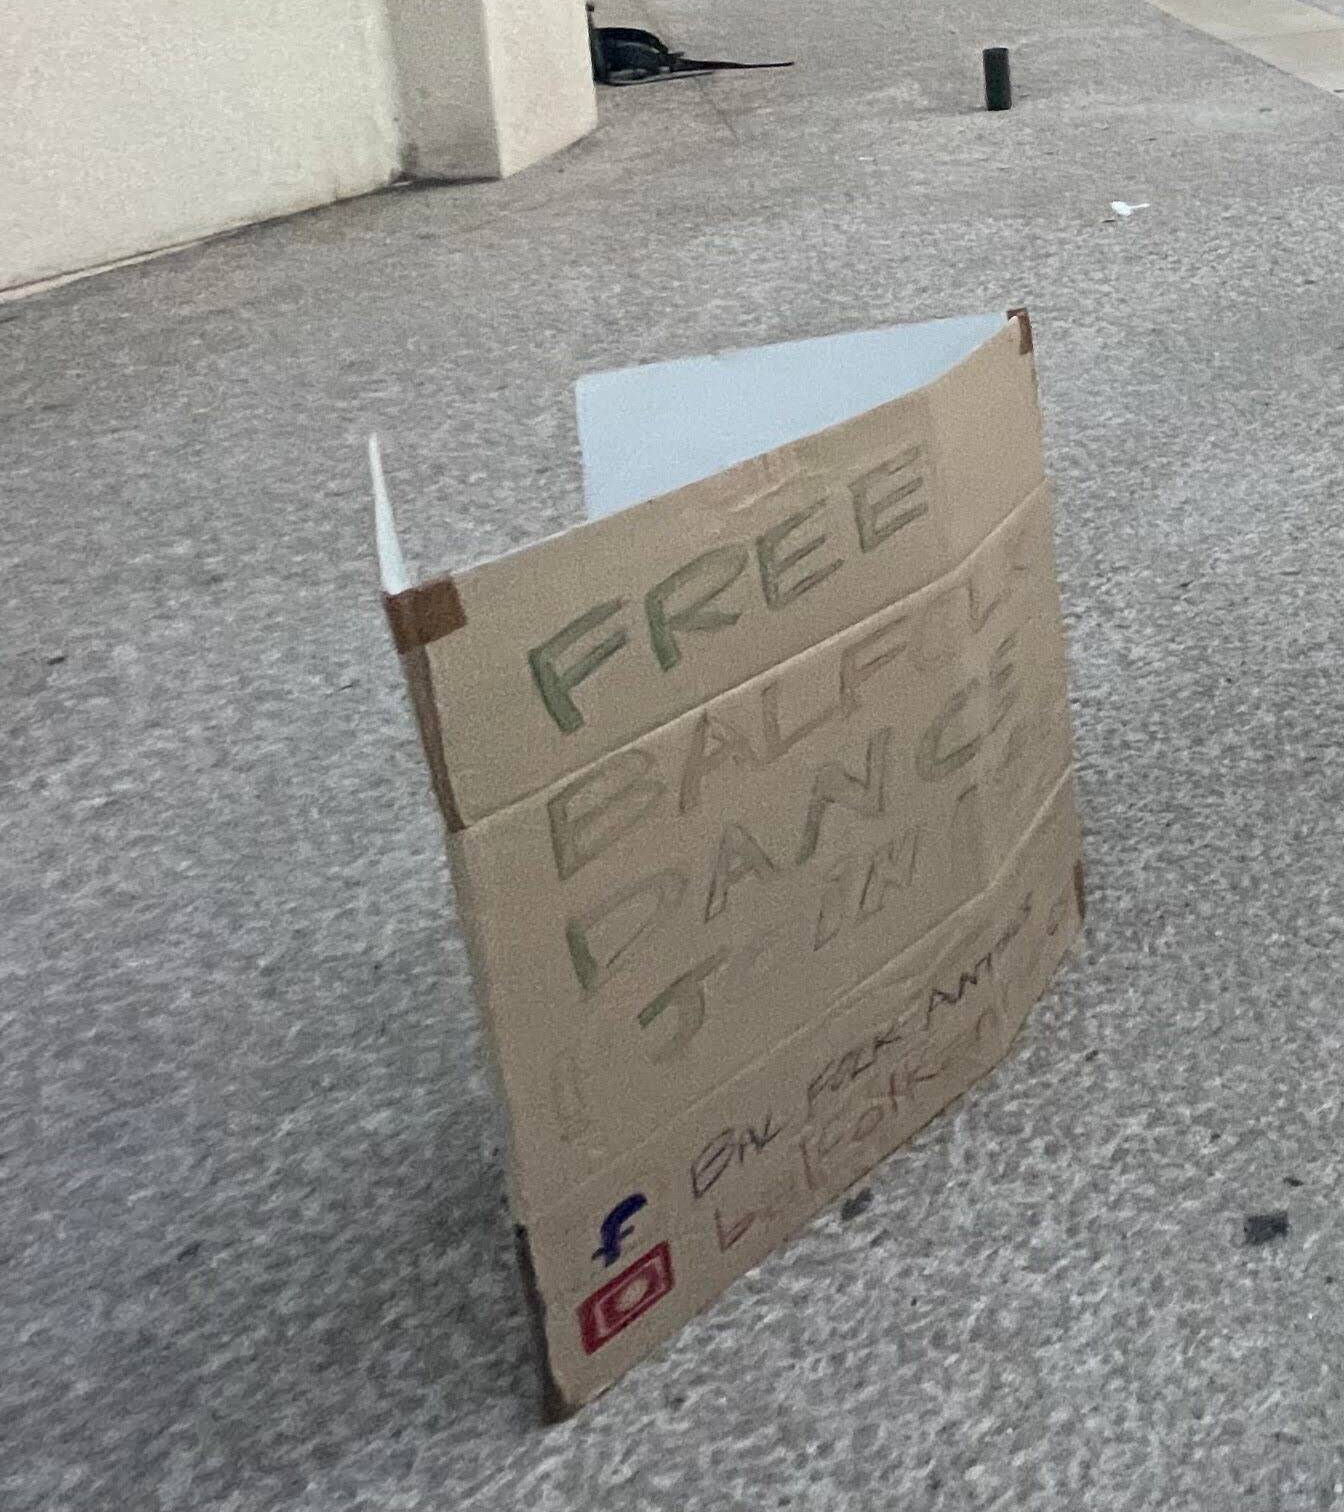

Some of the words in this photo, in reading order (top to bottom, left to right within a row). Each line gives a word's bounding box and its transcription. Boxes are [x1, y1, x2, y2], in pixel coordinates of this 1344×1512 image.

[528, 444, 929, 735] FREE
[564, 630, 1022, 1002] DANCE
[690, 1110, 784, 1200] BAL
